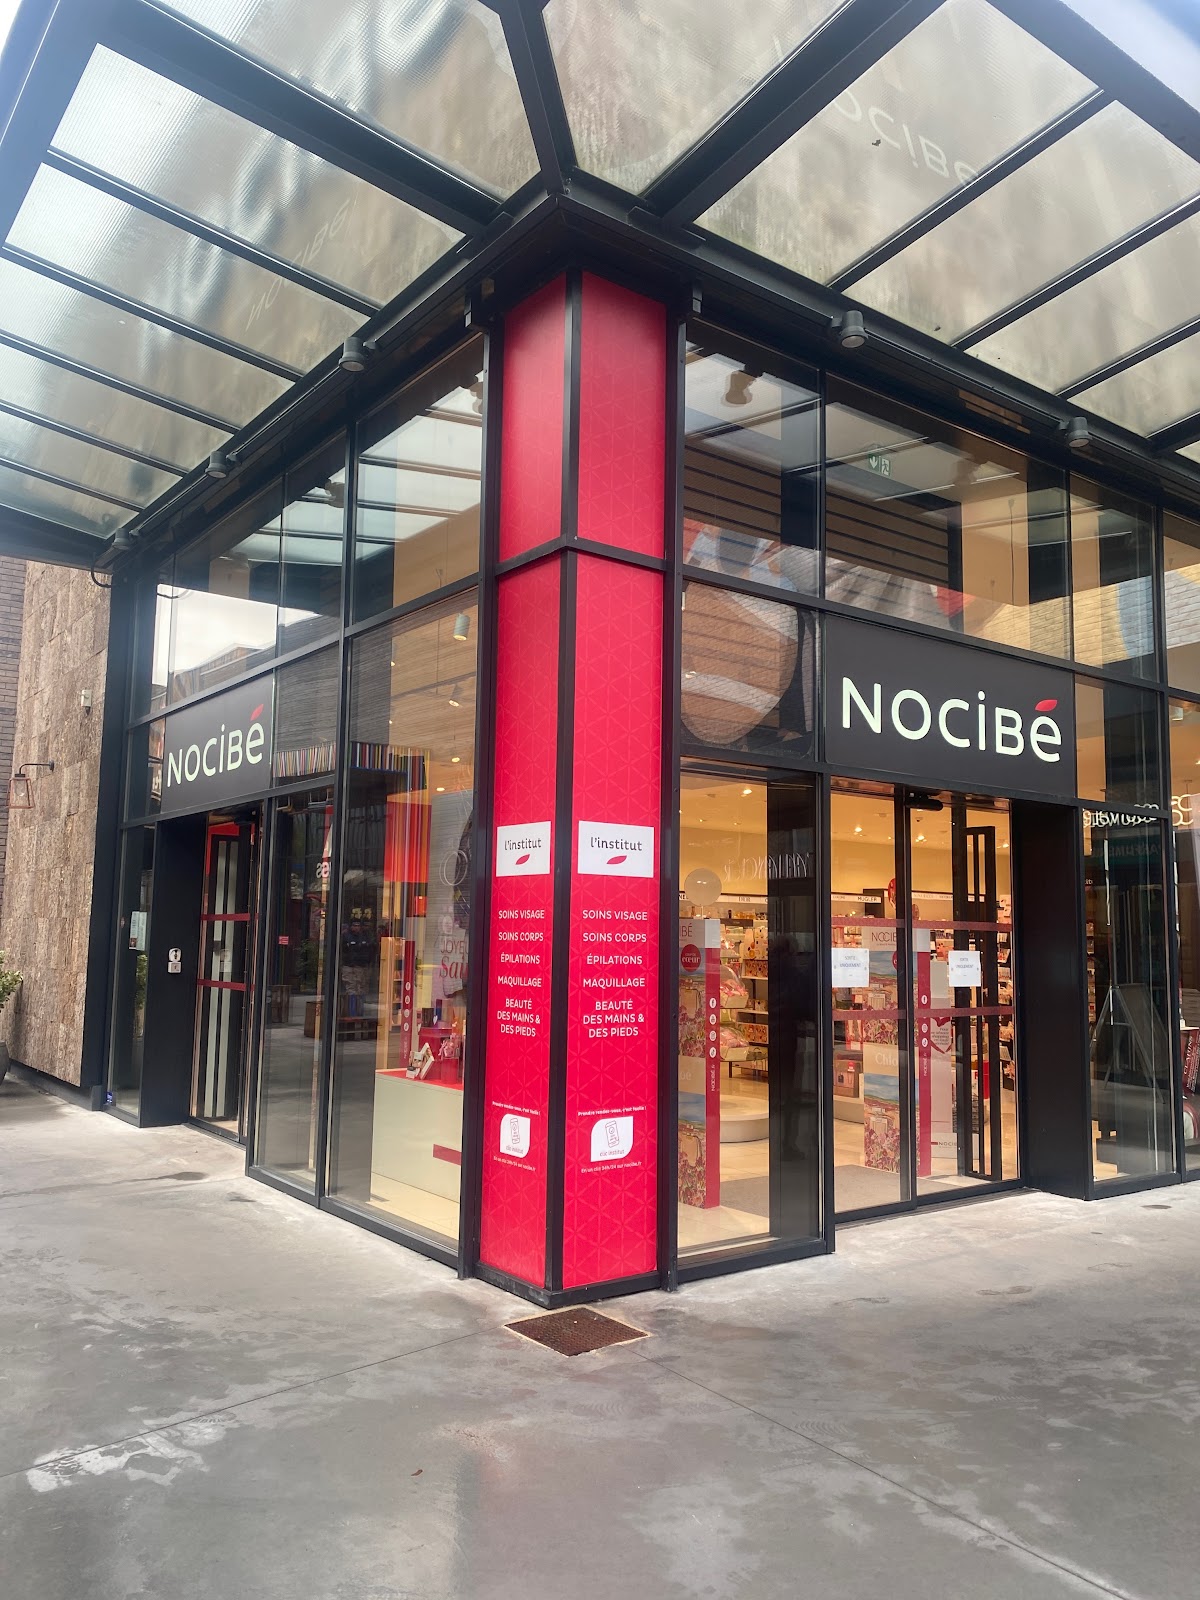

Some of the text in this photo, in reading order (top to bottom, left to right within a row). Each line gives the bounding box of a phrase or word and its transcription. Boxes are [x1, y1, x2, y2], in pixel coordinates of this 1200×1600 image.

[504, 837, 542, 851] l'institut
[590, 837, 643, 852] l'institut
[498, 910, 545, 919] SOINS VISAGE
[582, 910, 648, 921] SOINS VISAGE
[498, 932, 544, 942] SOINS CORPS
[582, 933, 647, 942] SOINS CORPS
[500, 952, 540, 964] ÉPILATIONS
[586, 953, 643, 965] ÉPILATIONS
[497, 976, 542, 987] MAQUILLAGE
[583, 978, 646, 989] MAQUILLAGE
[505, 997, 532, 1009] BEAUTÉ
[595, 998, 633, 1011] BEAUTÉ
[497, 1011, 540, 1024] DES MAINS &
[583, 1013, 645, 1024] DES MAINS &
[500, 1024, 536, 1037] DES PIEDS
[589, 1027, 639, 1038] DES PIEDS
